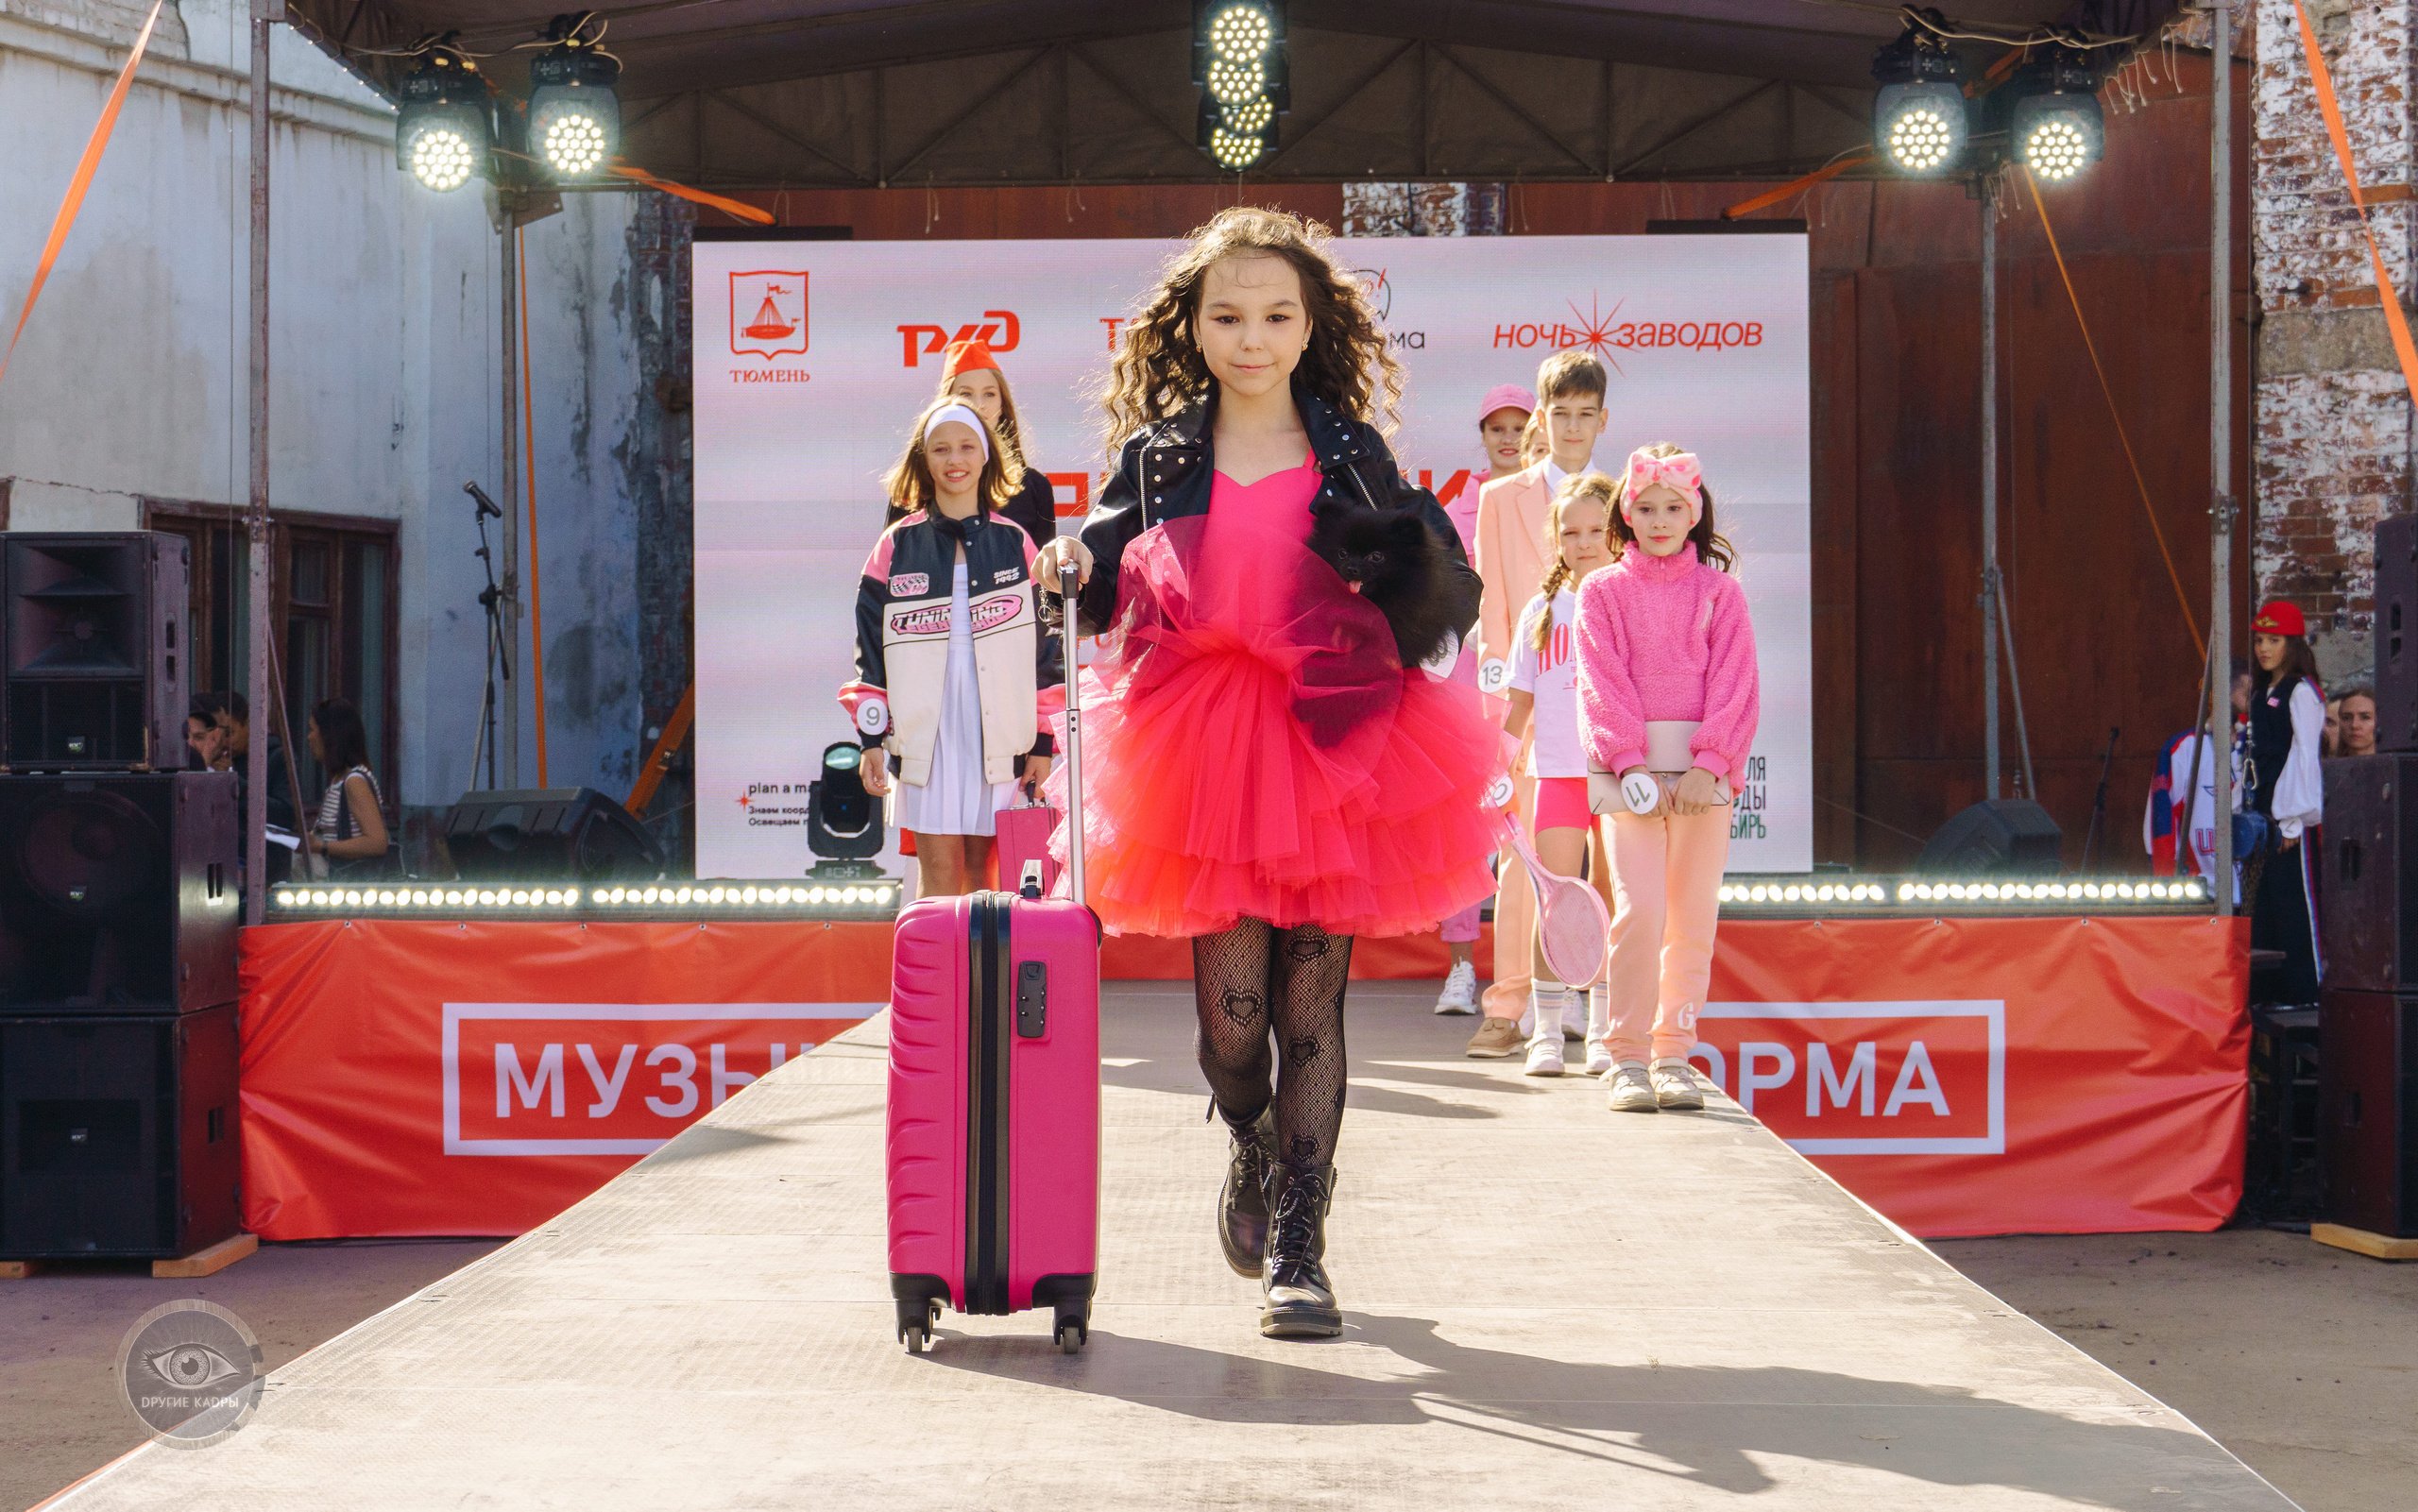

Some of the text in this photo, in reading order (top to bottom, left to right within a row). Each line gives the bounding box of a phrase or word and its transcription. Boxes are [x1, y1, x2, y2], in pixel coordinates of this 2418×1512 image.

[729, 369, 810, 383] ТЮМЕНЬ
[994, 567, 1019, 579] SINCE
[995, 571, 1020, 585] 1992
[1482, 665, 1503, 686] 13
[866, 705, 880, 726] 9
[1745, 756, 1765, 781] ЛЯ
[749, 782, 778, 796] plan
[783, 785, 791, 793] a
[1626, 781, 1651, 808] 11
[749, 806, 779, 814] Знаем
[1677, 1002, 1695, 1030] G
